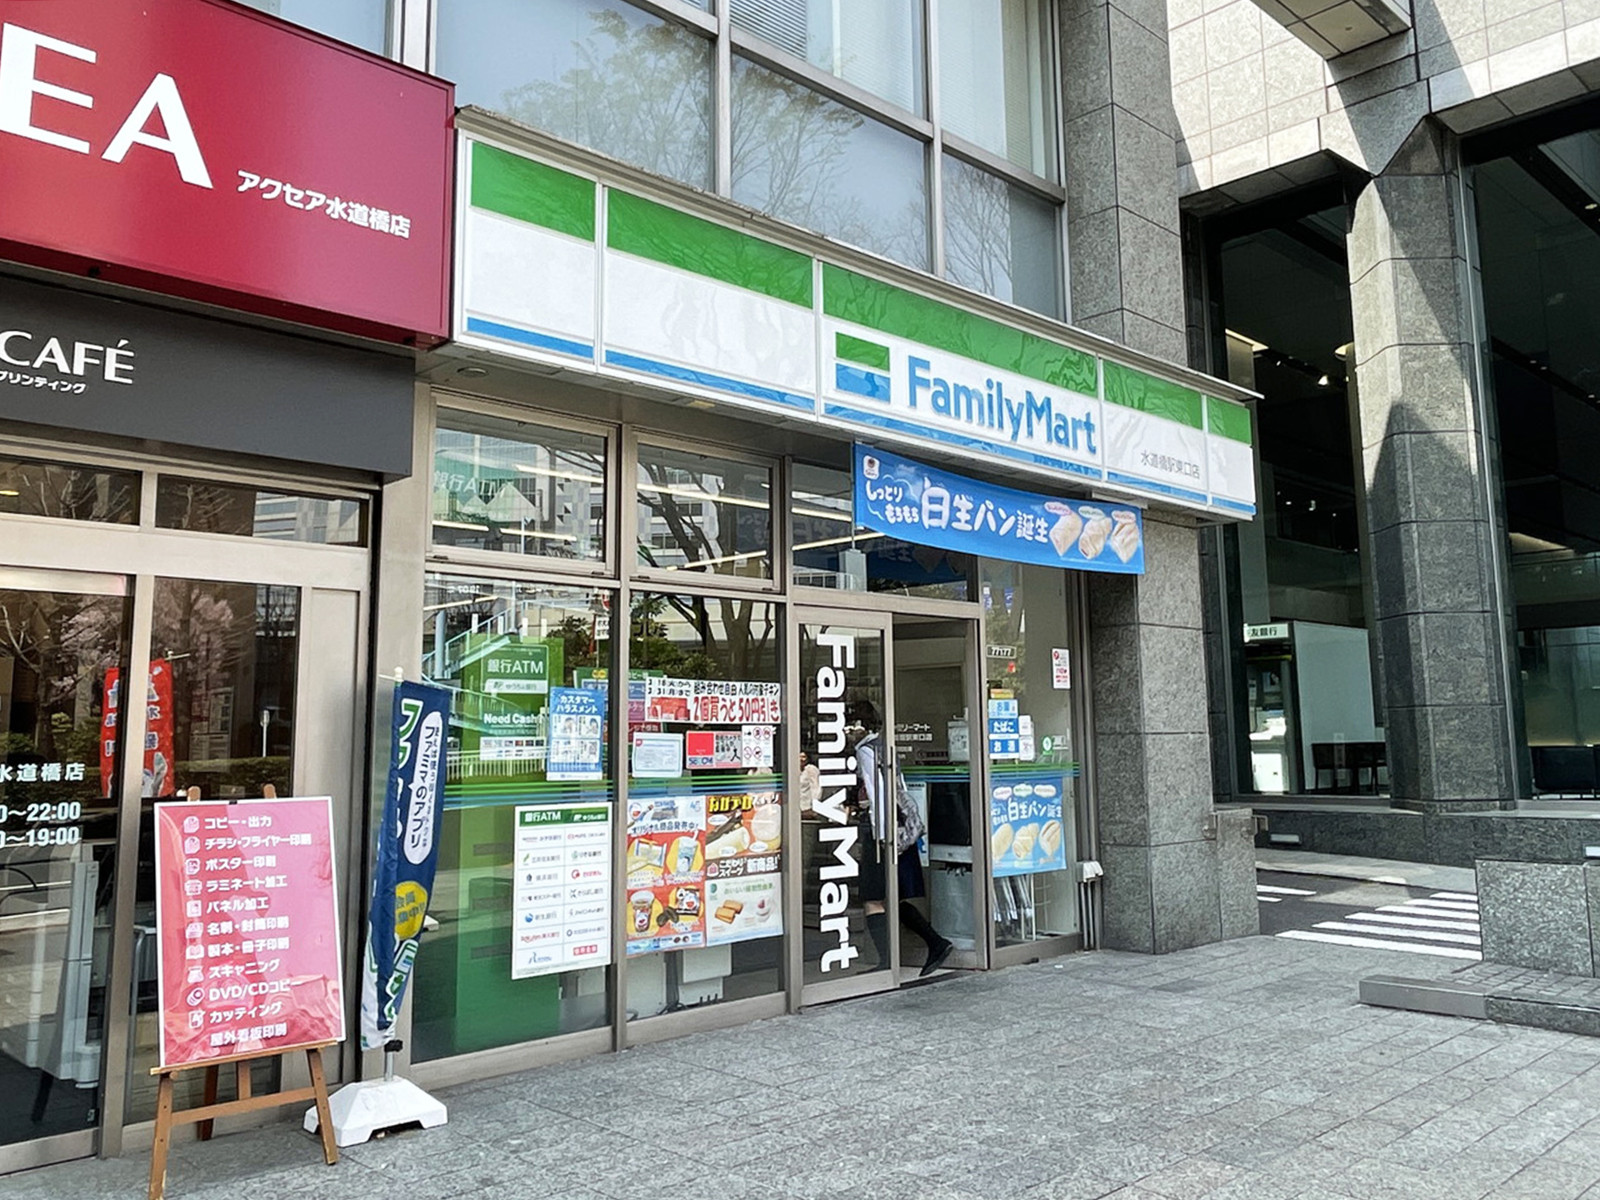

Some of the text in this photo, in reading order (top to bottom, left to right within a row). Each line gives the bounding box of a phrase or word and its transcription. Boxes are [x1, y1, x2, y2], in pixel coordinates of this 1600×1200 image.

[237, 169, 411, 239] アクセア水道橋店
[0, 330, 135, 385] CAFÉ
[907, 354, 1097, 455] FamilyMart
[1140, 450, 1200, 480] 水道橋駅東口店
[865, 480, 903, 502] しっとり
[1247, 626, 1278, 637] 友銀行
[487, 659, 543, 674] 銀行ATM
[556, 704, 598, 714] ハラスメント
[560, 695, 595, 704] カスタマー
[693, 696, 780, 722] 2個買うと50円引き
[483, 713, 511, 724] Need
[410, 725, 437, 850] ファミマのアプリ
[812, 632, 860, 974] FamilyMart
[524, 811, 561, 822] 銀行ATM
[205, 855, 277, 871] ポスター印刷
[205, 875, 288, 893] ラミネート加工
[206, 896, 269, 913] パネル加工
[208, 958, 281, 978] スキャニング
[208, 980, 302, 1001] DVD/CDコピー
[209, 1001, 283, 1024] カッティング
